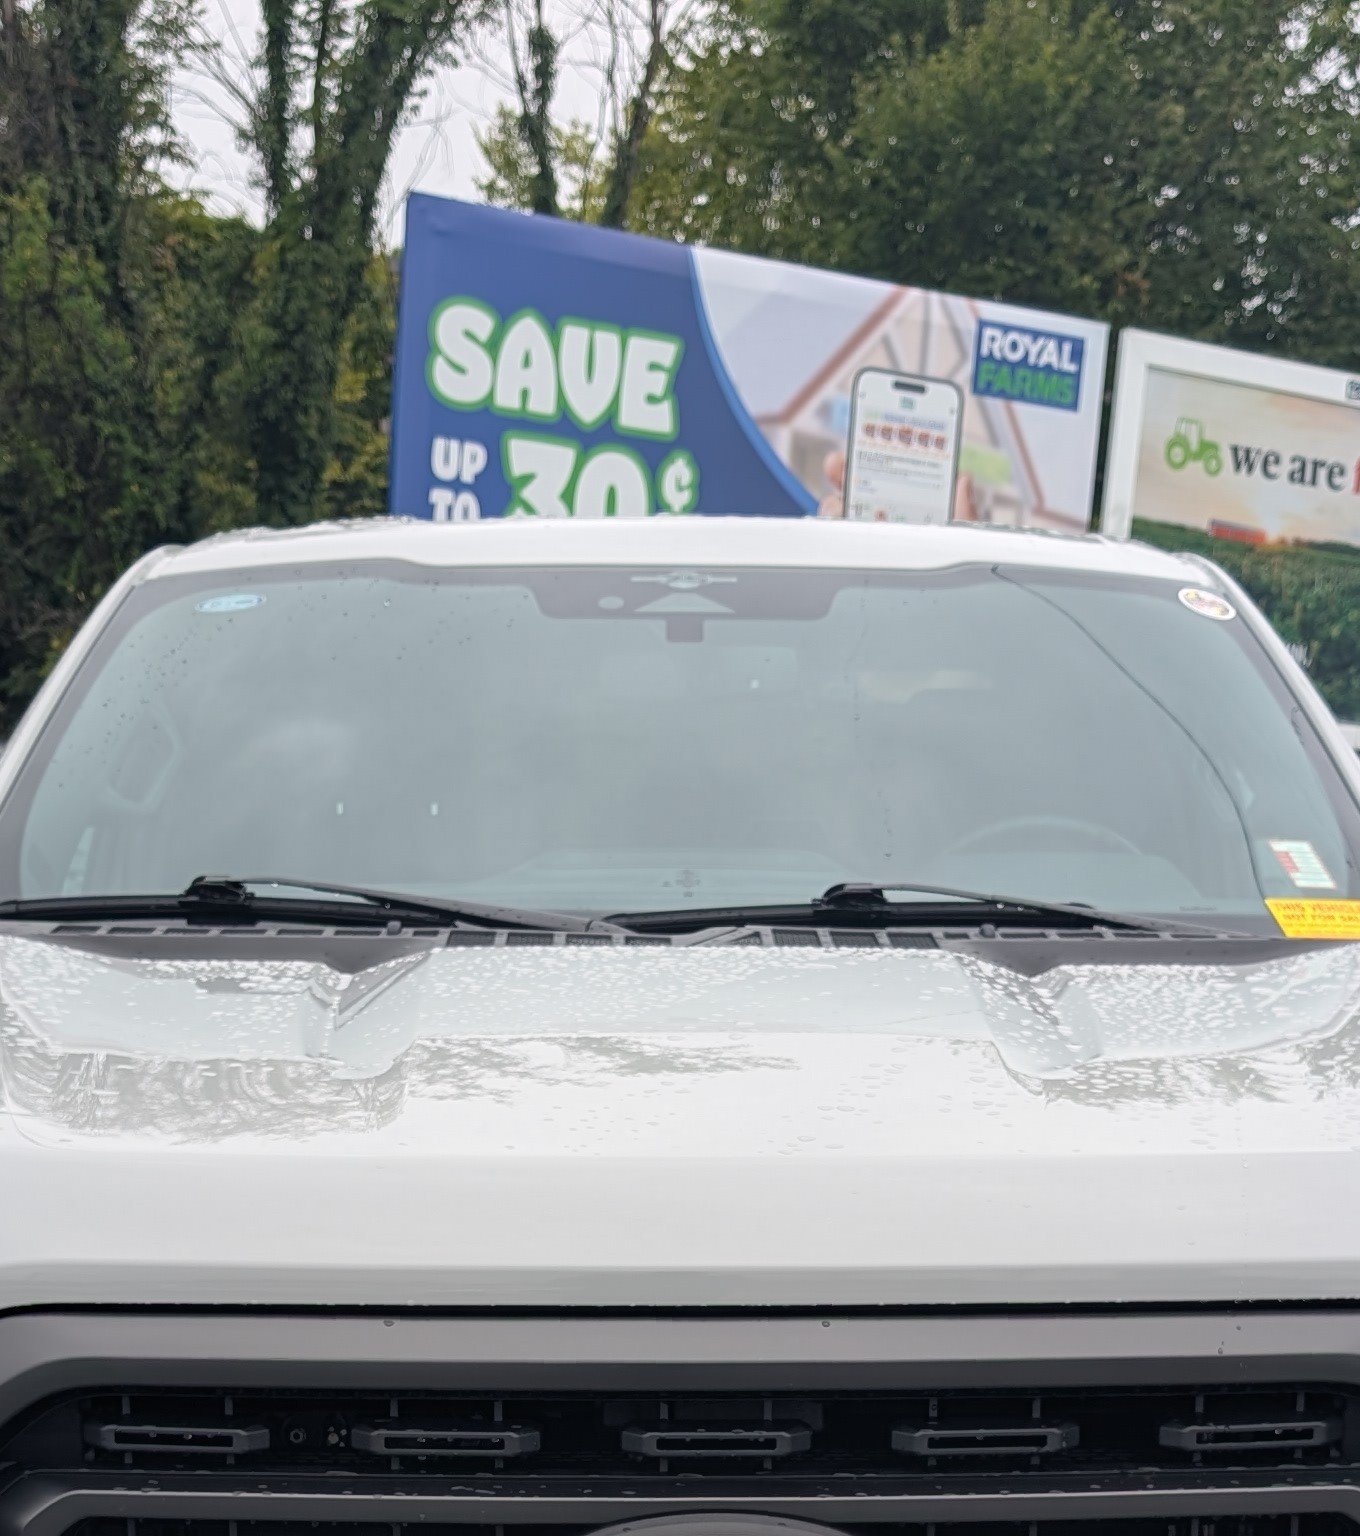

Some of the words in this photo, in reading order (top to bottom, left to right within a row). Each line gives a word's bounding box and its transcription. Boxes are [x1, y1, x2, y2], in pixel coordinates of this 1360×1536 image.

[430, 302, 677, 434] SAVE
[981, 326, 1078, 373] ROYAL
[978, 361, 1073, 404] FARMS
[430, 436, 488, 483] UP
[1229, 443, 1281, 480] we
[1288, 454, 1346, 492] are
[428, 487, 481, 520] TO
